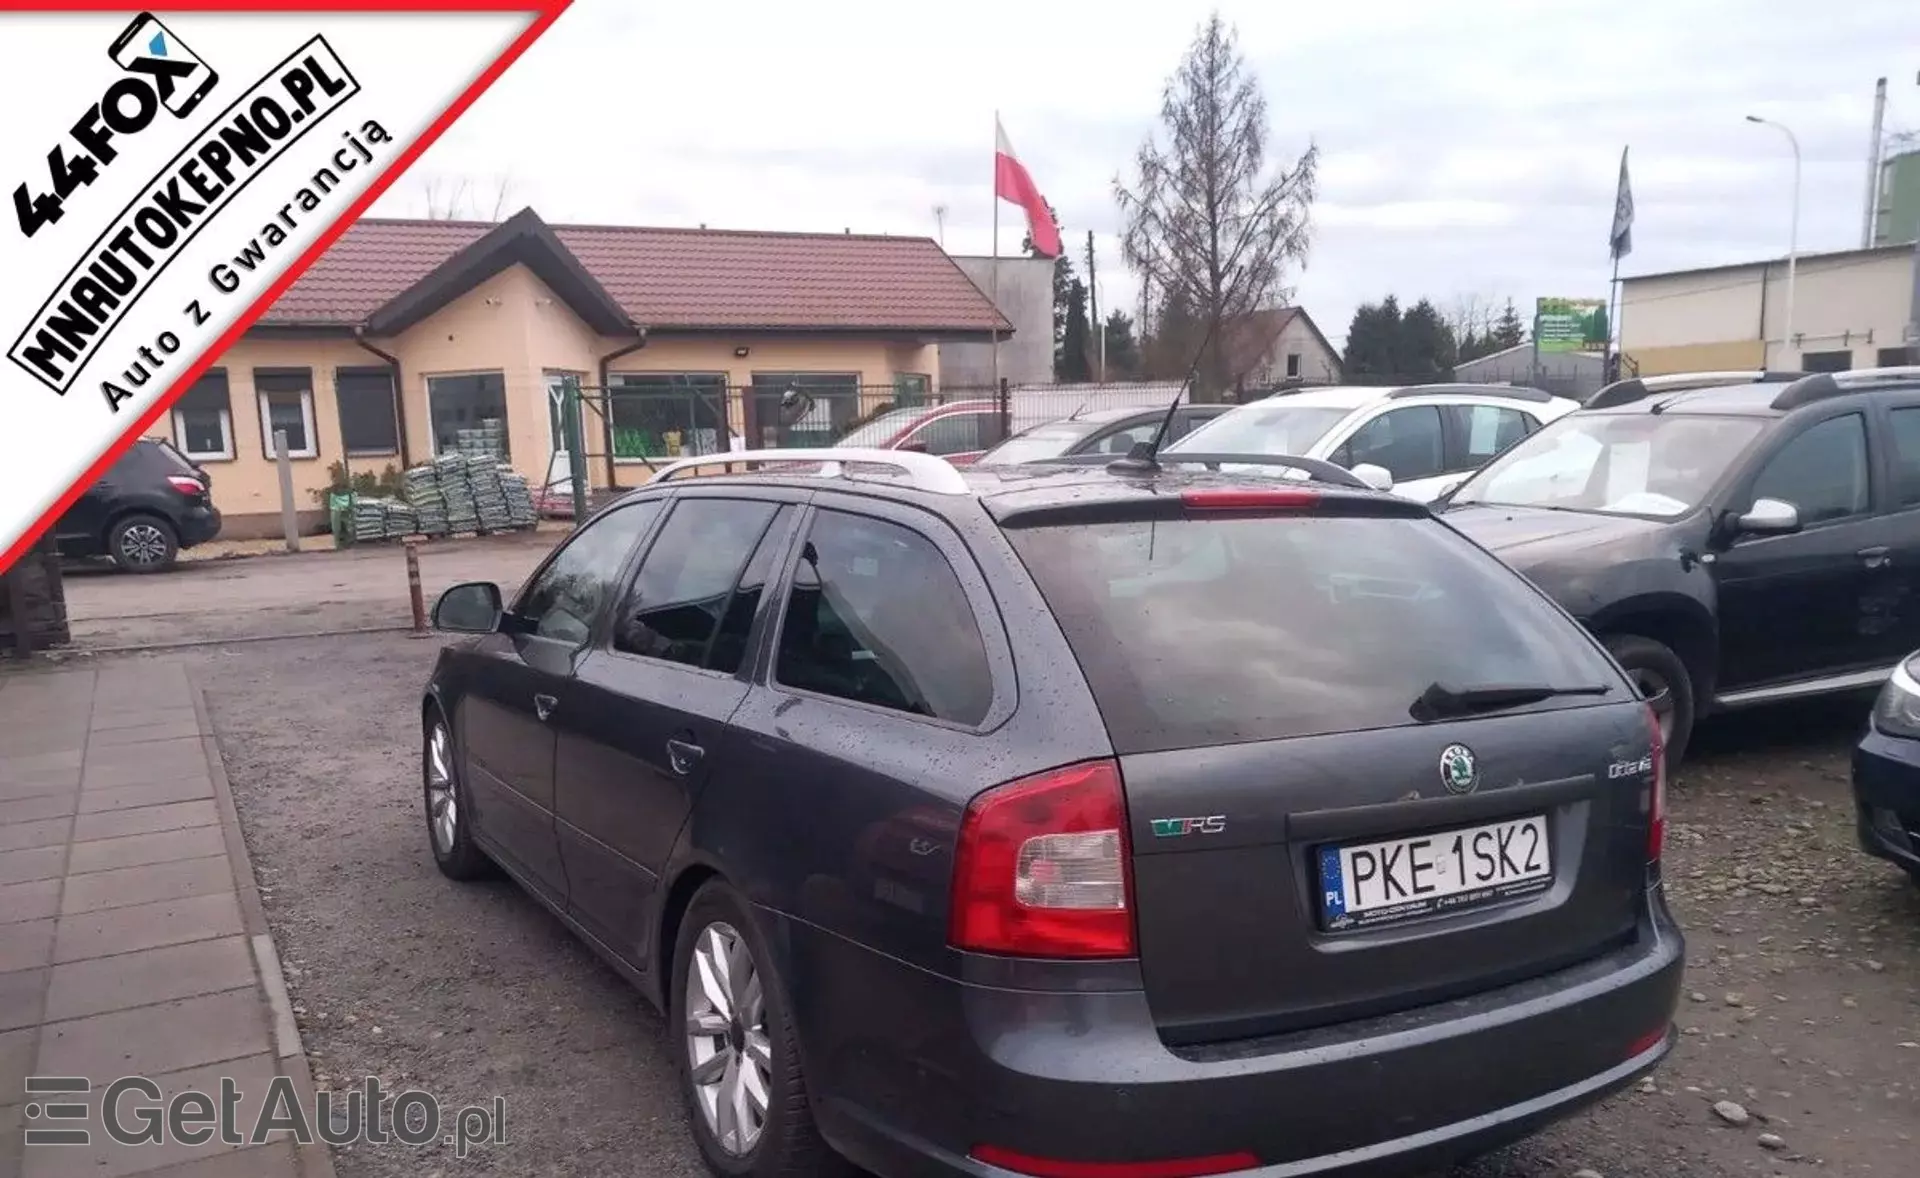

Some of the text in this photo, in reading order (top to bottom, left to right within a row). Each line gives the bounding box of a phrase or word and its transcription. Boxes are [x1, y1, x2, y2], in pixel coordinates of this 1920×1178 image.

[1351, 823, 1541, 906] PKE 1SK2
[1325, 891, 1342, 907] PL
